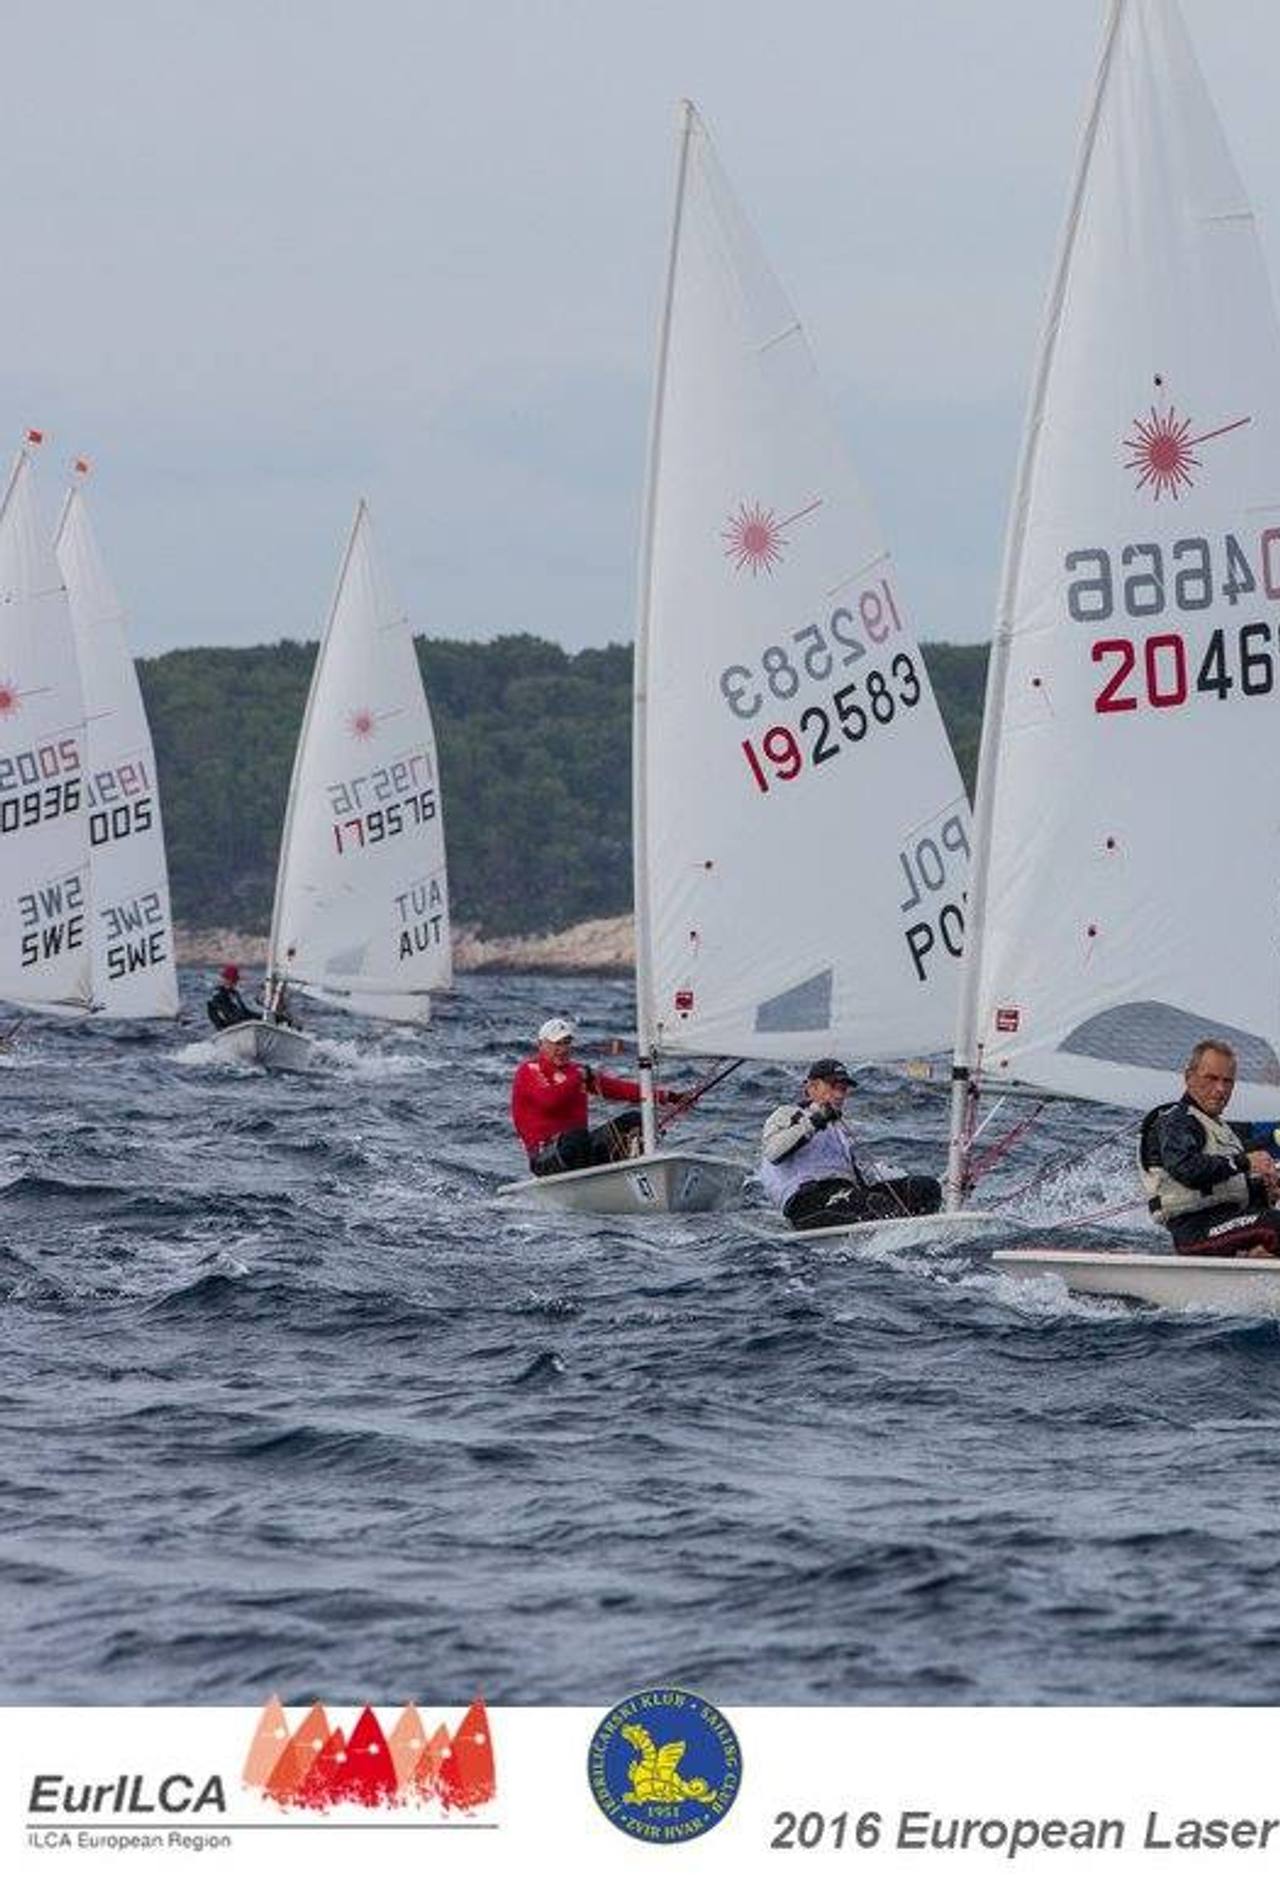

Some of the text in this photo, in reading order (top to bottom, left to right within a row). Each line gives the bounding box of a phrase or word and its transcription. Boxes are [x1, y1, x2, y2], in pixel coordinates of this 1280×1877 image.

[741, 653, 921, 794] 192583
[1, 778, 81, 833] 0936
[90, 798, 152, 846] 005
[333, 788, 436, 855] 179576
[21, 914, 84, 967] SWE
[107, 931, 167, 979] SWE
[400, 914, 442, 961] AUT
[905, 892, 967, 981] PO
